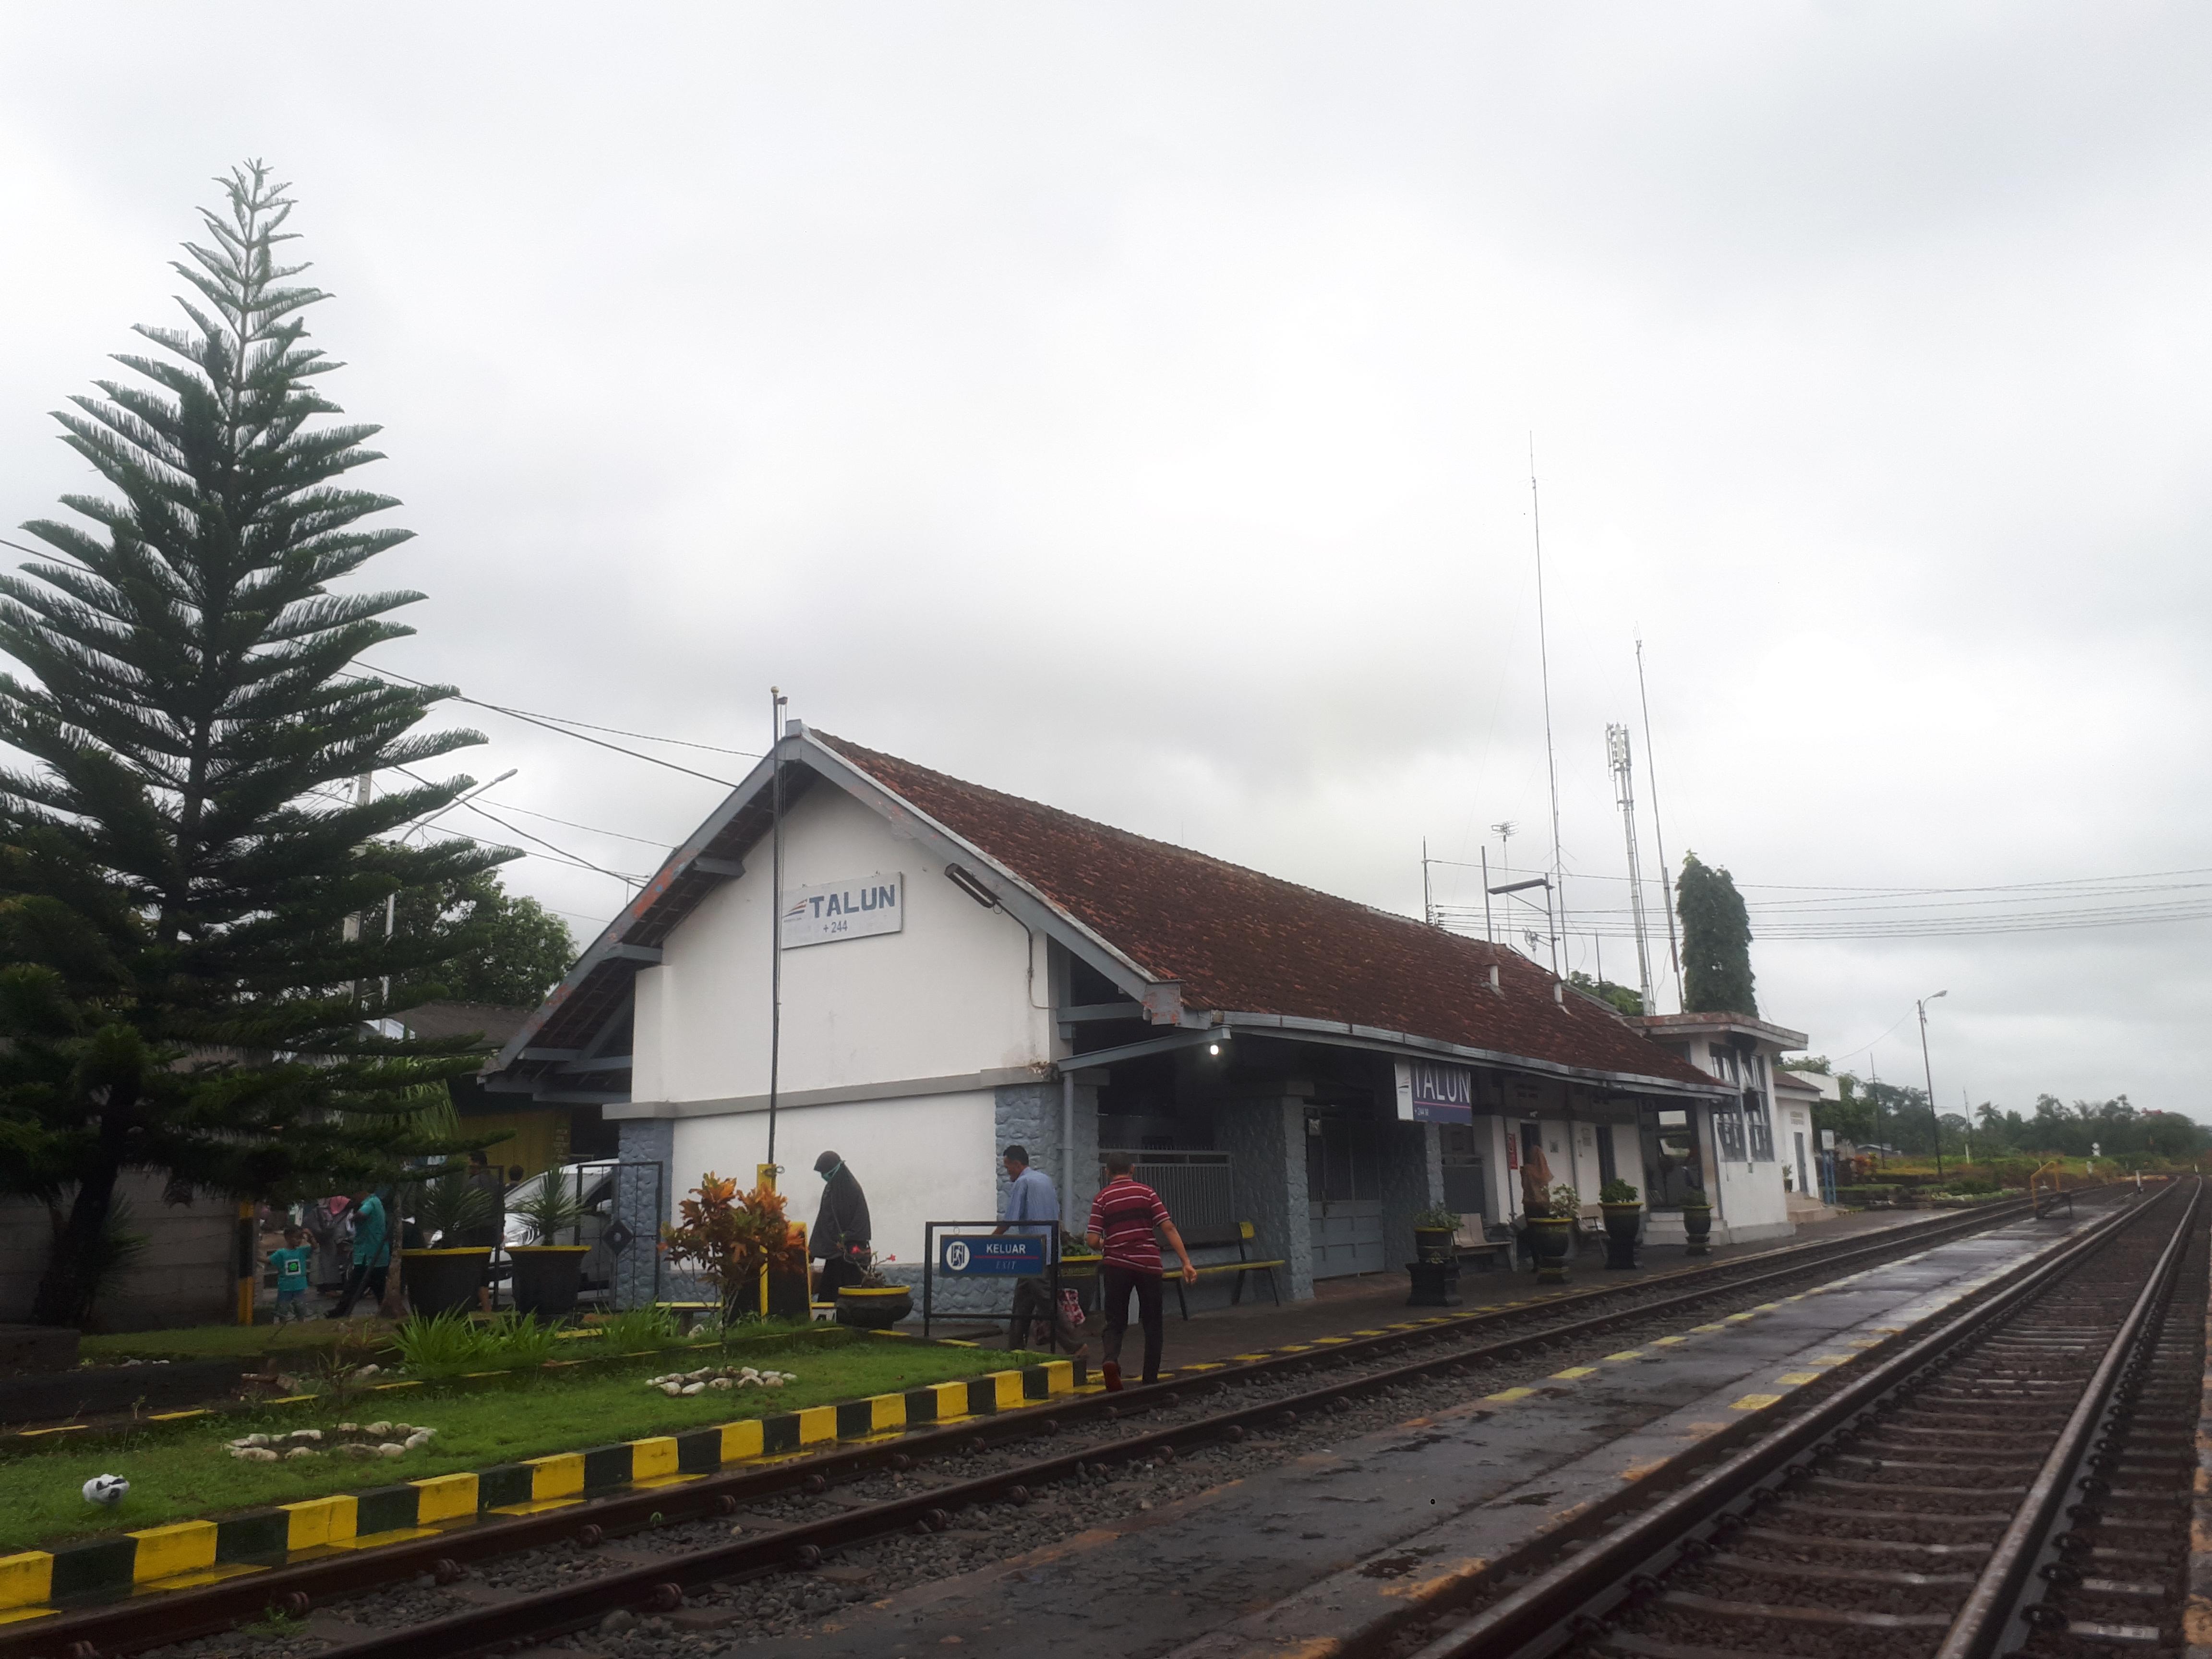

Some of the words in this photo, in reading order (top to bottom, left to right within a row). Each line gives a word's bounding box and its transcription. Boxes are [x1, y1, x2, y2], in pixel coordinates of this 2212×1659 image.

[809, 884, 895, 918] TALUN
[986, 1243, 1026, 1254] KELUAR
[996, 1261, 1016, 1270] EXIT
